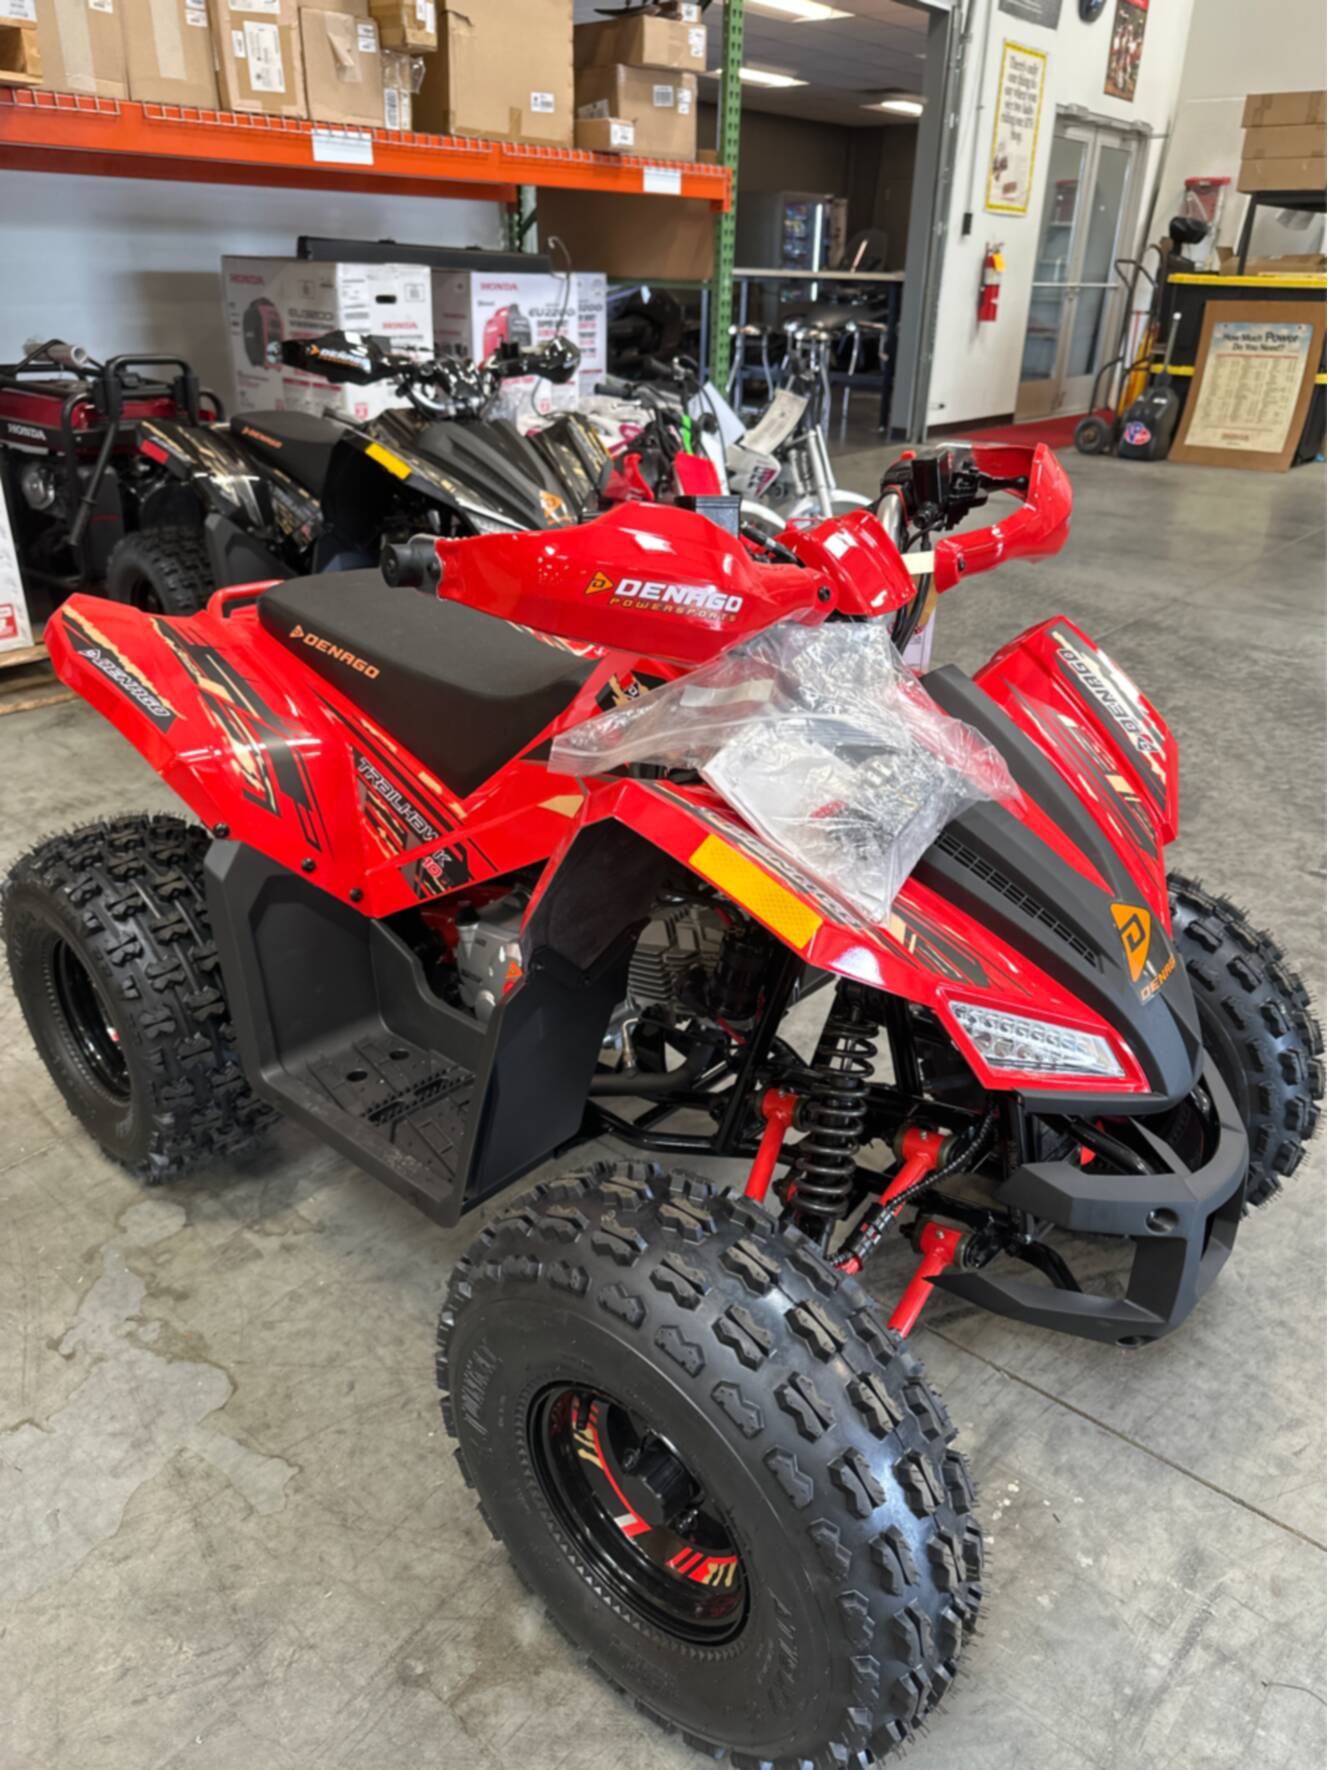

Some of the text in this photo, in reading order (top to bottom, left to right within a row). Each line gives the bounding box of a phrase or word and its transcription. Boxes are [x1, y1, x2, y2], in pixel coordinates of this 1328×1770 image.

[480, 282, 518, 291] HONDA
[382, 322, 417, 330] HONDA
[1222, 331, 1299, 343] How Much Power
[1232, 343, 1286, 352] Do You Need?
[8, 422, 47, 441] HONDA
[614, 577, 743, 613] DENAGO
[609, 597, 737, 623] POWERSPORTS
[303, 632, 381, 680] DENAGO
[95, 651, 171, 718] DENAGO
[1056, 648, 1140, 733] DENAGO
